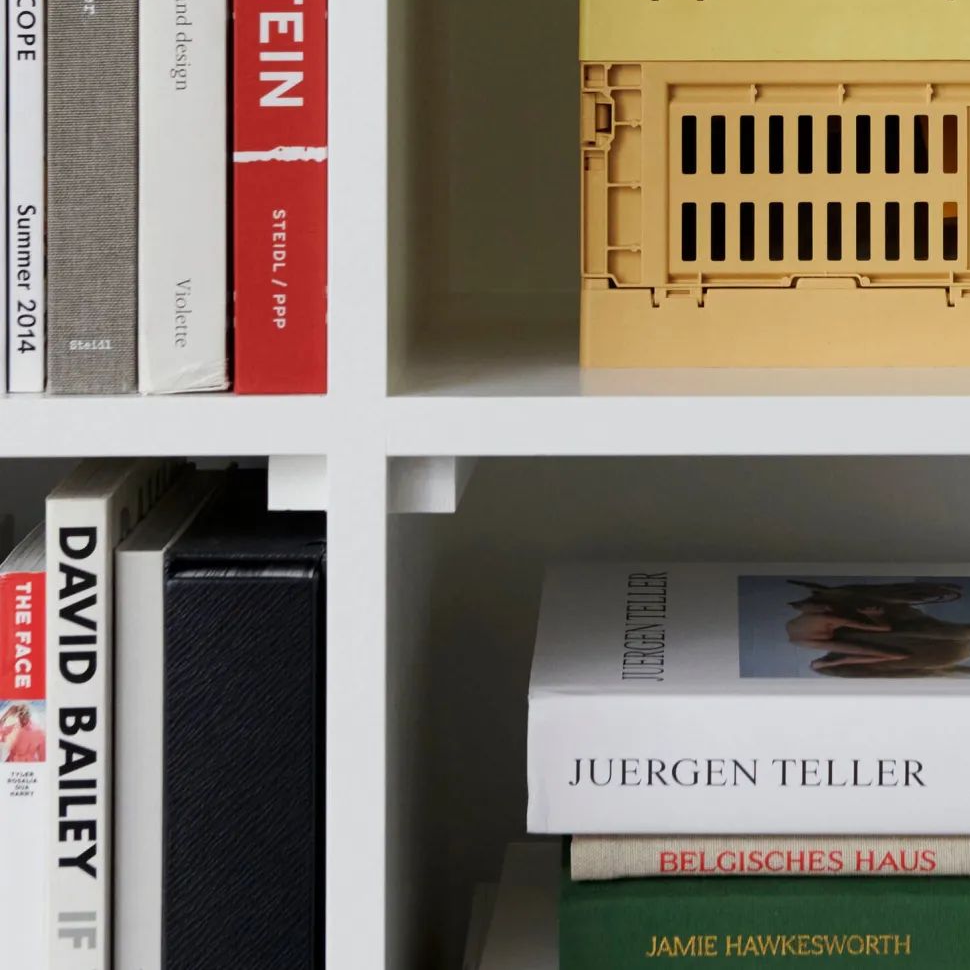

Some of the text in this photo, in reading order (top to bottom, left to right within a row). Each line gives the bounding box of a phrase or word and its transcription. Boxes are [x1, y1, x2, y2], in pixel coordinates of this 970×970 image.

[170, 32, 191, 90] design
[17, 205, 36, 354] Summer 2014
[273, 209, 286, 329] STEIDL PPP
[70, 338, 112, 350] Steidl
[175, 278, 191, 348] Violette
[15, 582, 32, 689] THE FACE
[622, 571, 668, 682] JUERGEN TELLER
[58, 527, 98, 950] DAVID BAILEY IF
[568, 758, 926, 788] JUERGEN TELLER
[659, 850, 937, 872] BELGISCHES HAUS
[645, 934, 911, 957] JAMIE HAWKESWORTH
